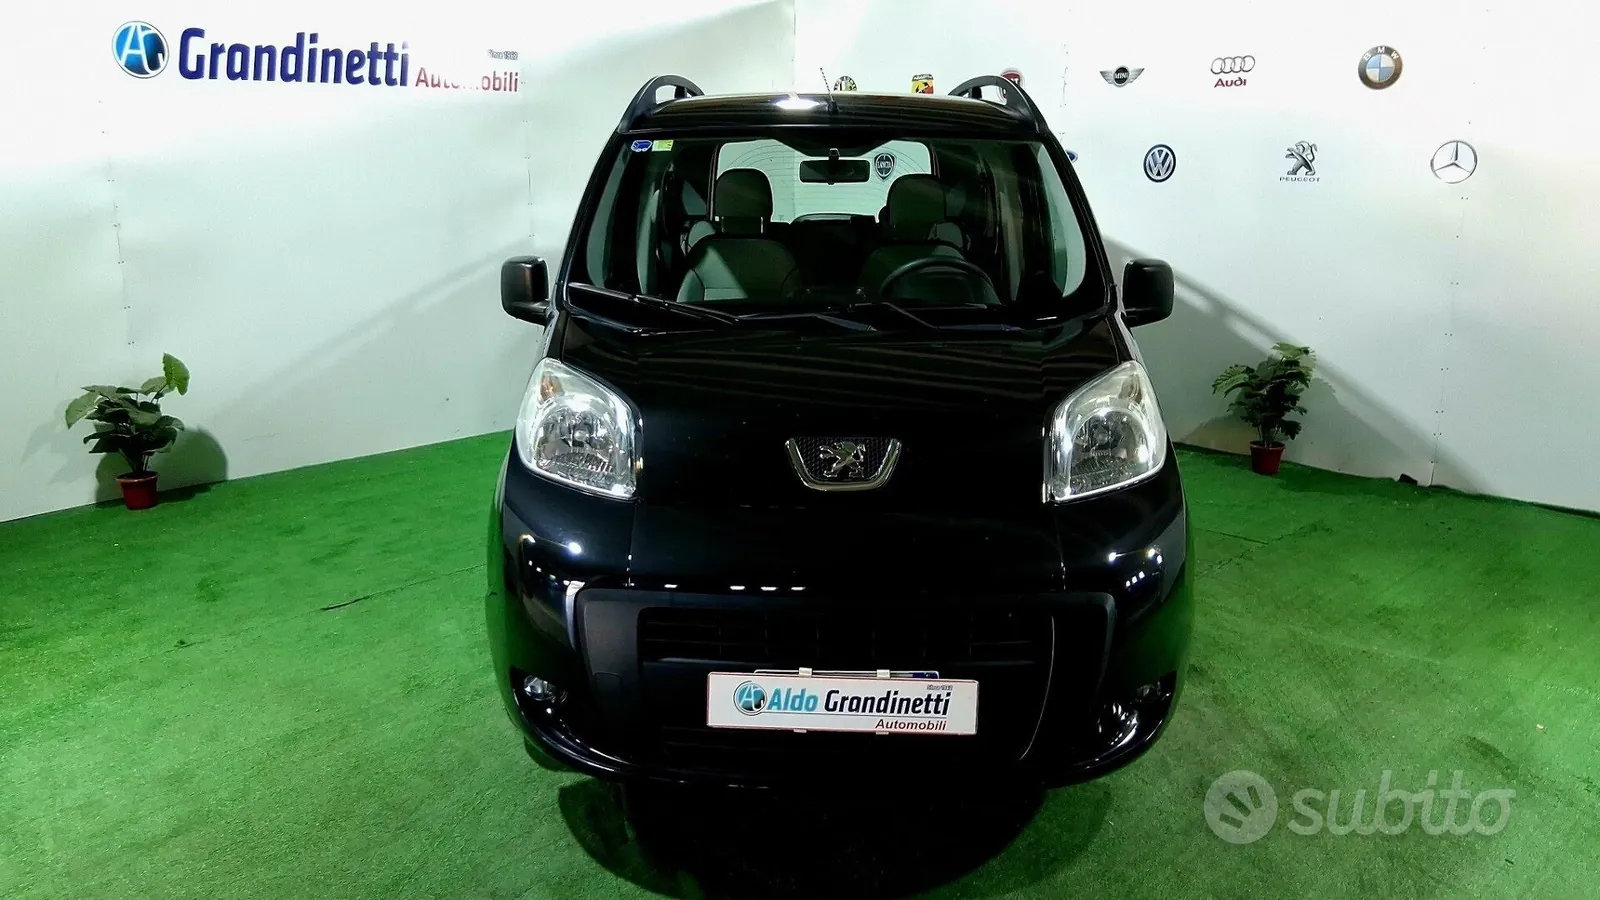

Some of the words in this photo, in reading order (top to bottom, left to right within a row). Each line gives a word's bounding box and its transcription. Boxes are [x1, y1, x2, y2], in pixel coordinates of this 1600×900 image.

[179, 27, 409, 88] Grandinetti
[1362, 46, 1400, 61] BMW
[1214, 77, 1247, 88] Audi
[767, 687, 819, 712] Aldo
[824, 690, 951, 716] Grandinetti
[875, 719, 947, 732] Automobili
